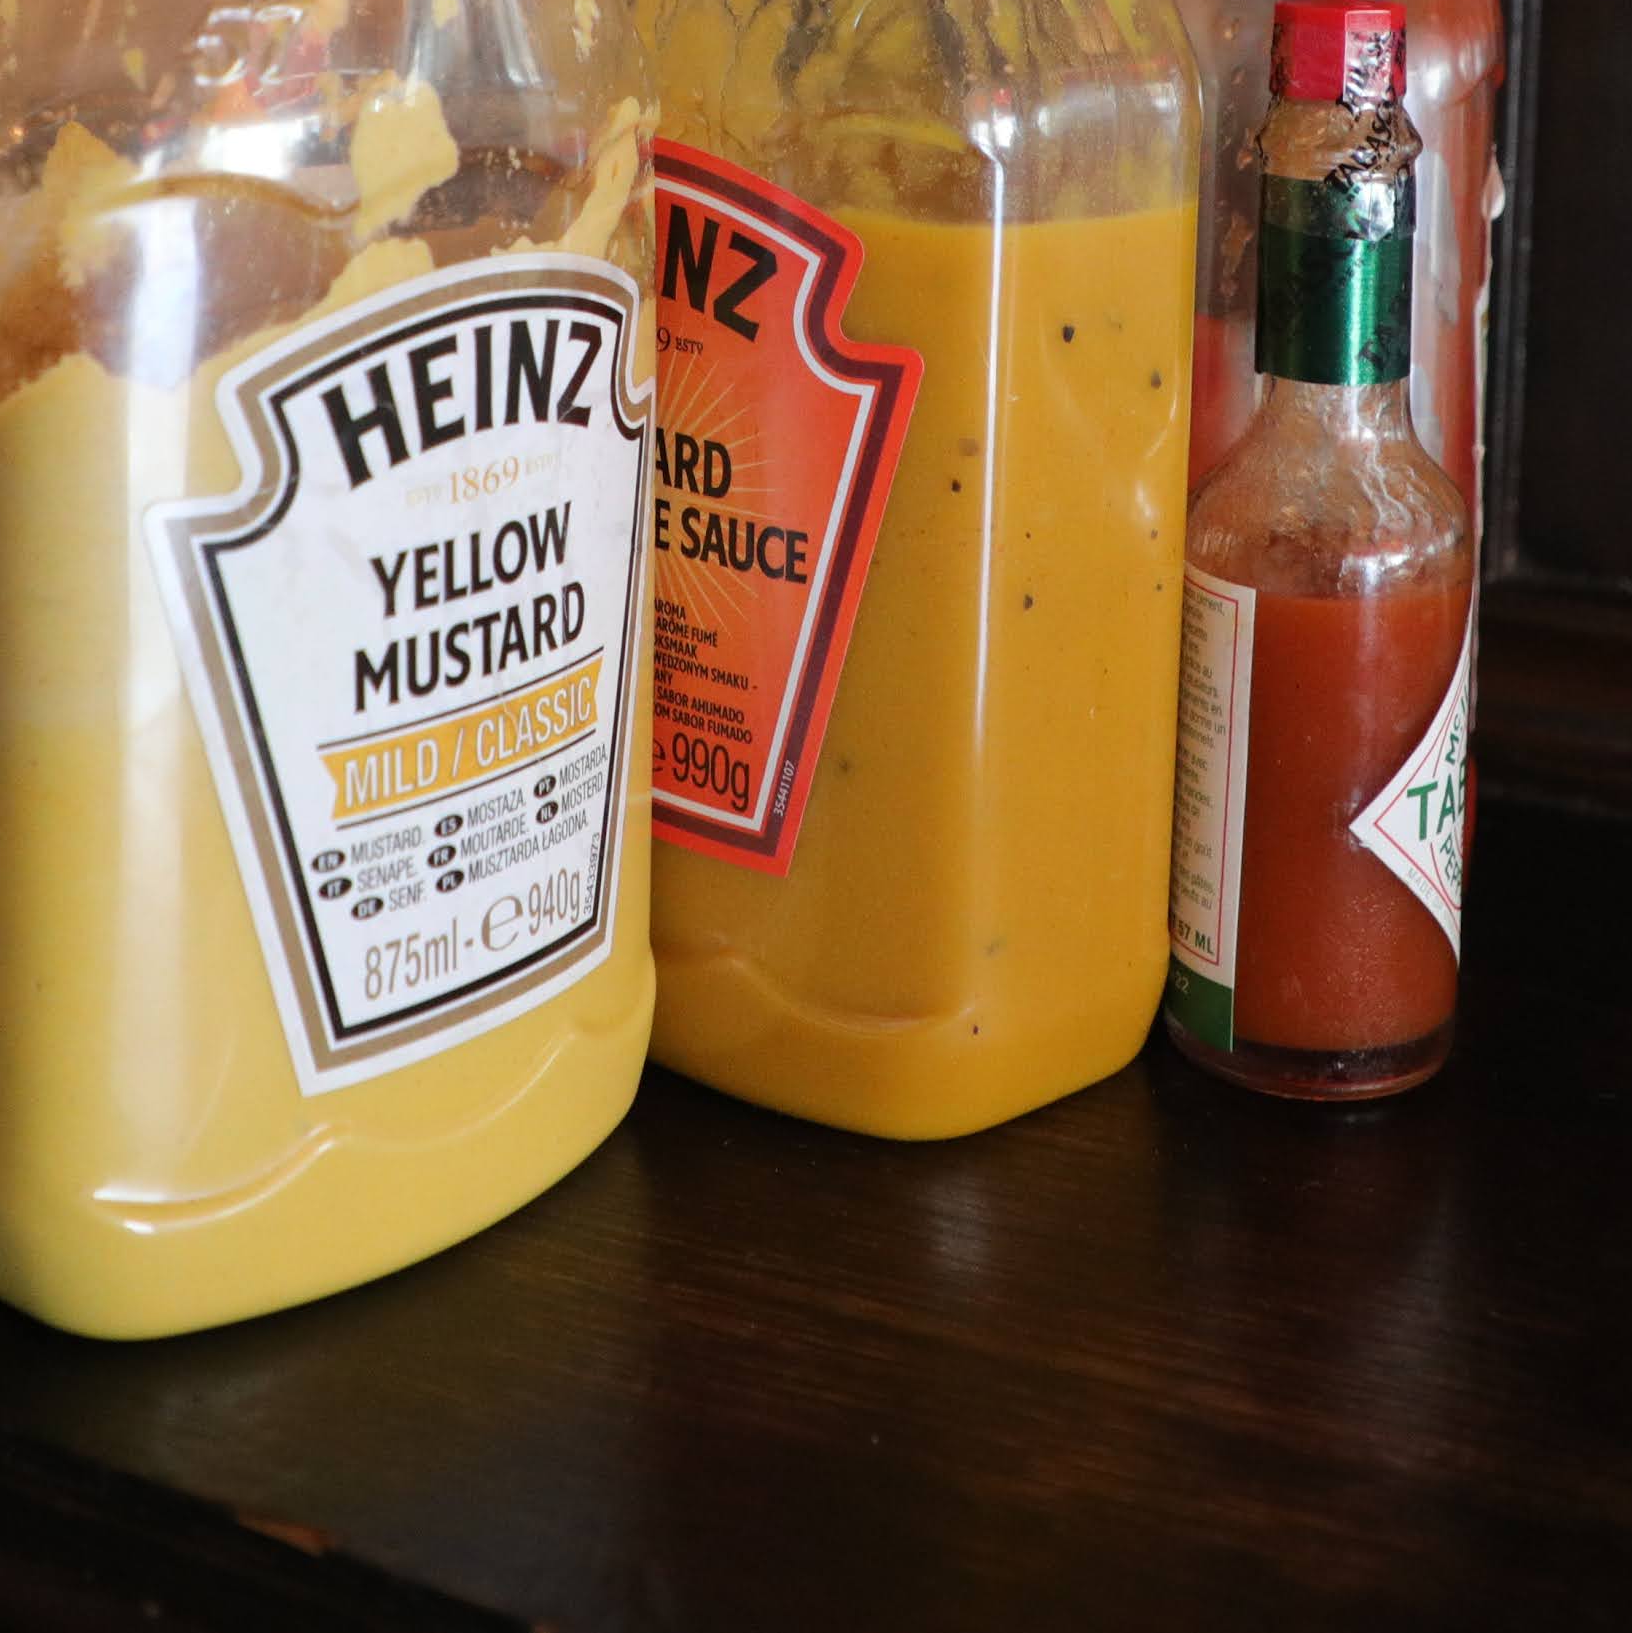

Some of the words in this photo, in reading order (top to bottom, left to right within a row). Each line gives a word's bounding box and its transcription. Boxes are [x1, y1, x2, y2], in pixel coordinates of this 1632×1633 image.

[320, 319, 603, 491] HEINZ
[449, 455, 520, 505] 1869
[368, 500, 572, 619] YELLOW
[680, 506, 808, 585] SAUCE
[352, 580, 586, 715] MUSTARD
[711, 667, 749, 691] SMAKU
[344, 738, 440, 809] MILD
[475, 674, 592, 768] CLASSIC
[657, 685, 689, 708] SABOR
[690, 697, 745, 725] AHUMADO
[671, 708, 705, 732] SABOR
[707, 718, 753, 744] FUMADO
[671, 731, 750, 812] 990g
[774, 759, 796, 817] 35441107
[467, 833, 541, 884] MUSZTARDA
[583, 831, 601, 916] 35433973
[364, 915, 459, 1002] 875ml
[528, 866, 581, 937] 940g
[1178, 919, 1191, 941] 57
[1195, 929, 1214, 957] ML
